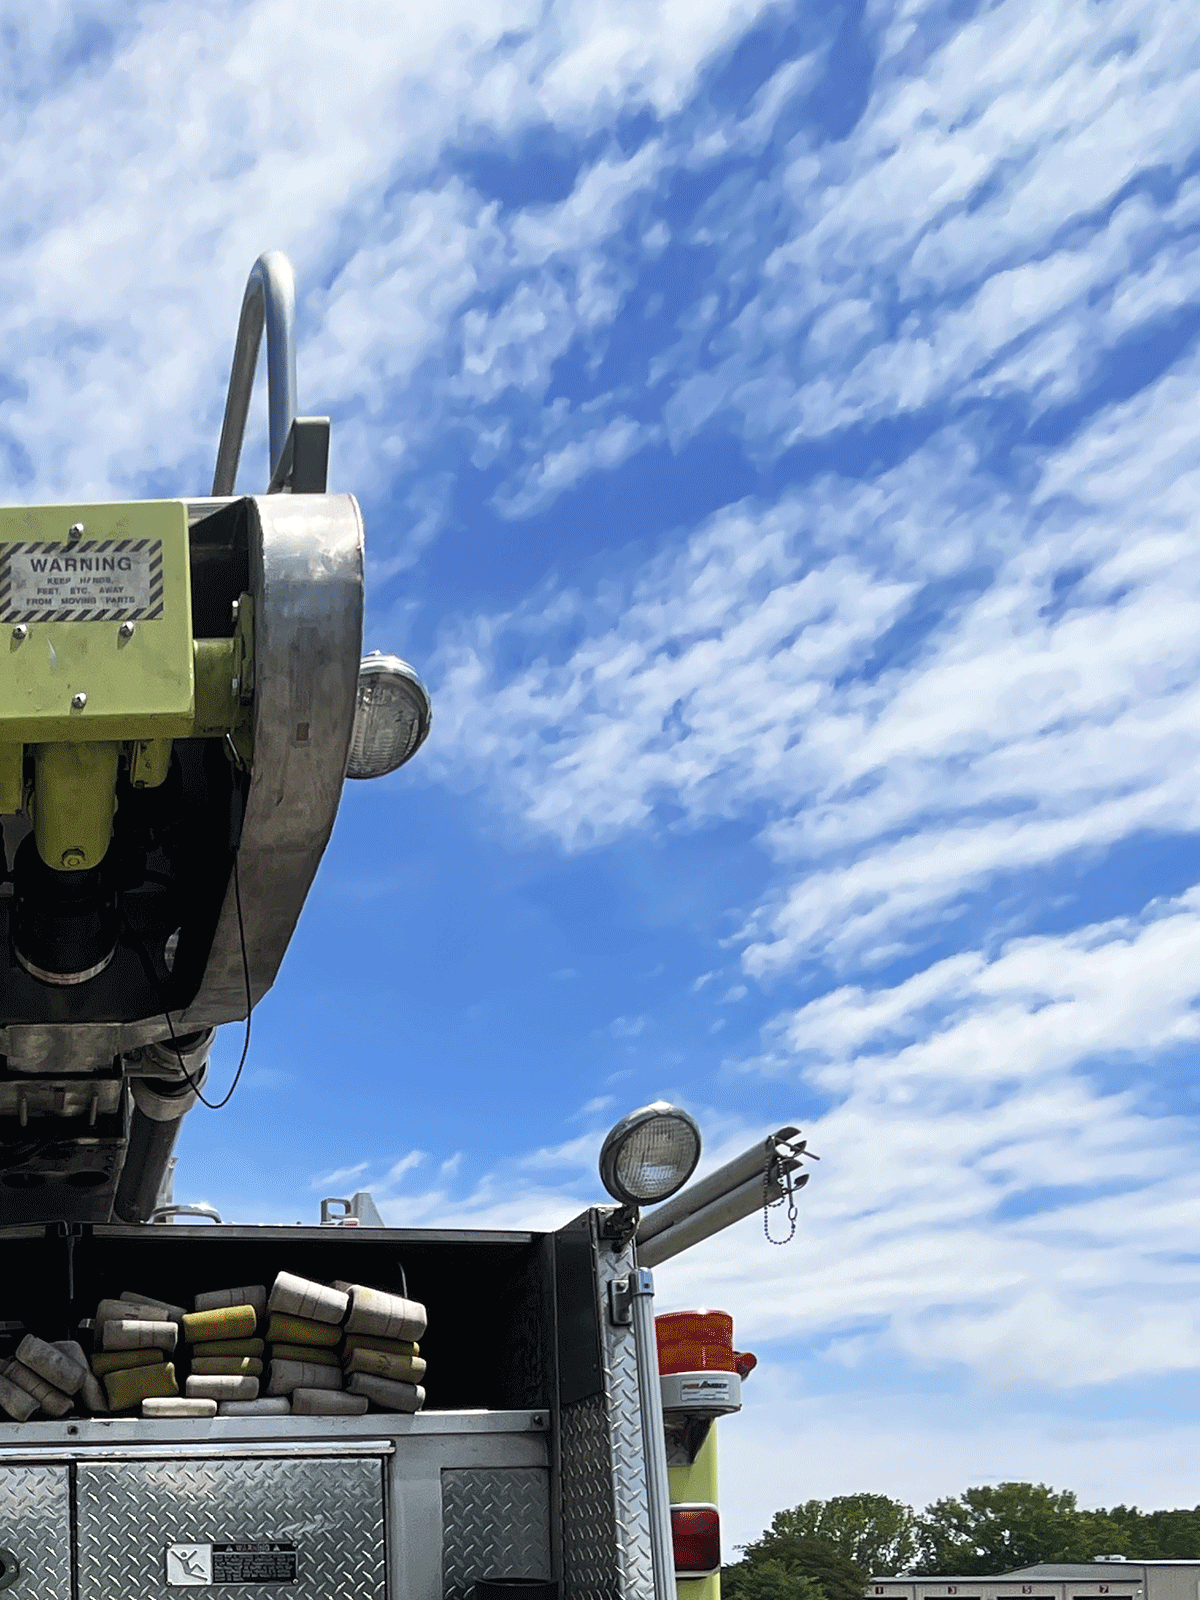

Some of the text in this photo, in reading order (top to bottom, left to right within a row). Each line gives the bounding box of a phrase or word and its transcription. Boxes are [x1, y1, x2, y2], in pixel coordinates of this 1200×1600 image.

[30, 556, 132, 573] WARNING
[47, 577, 71, 585] KEEP
[99, 586, 124, 594] AWAY
[26, 596, 135, 606] FROM MOVING PARTS
